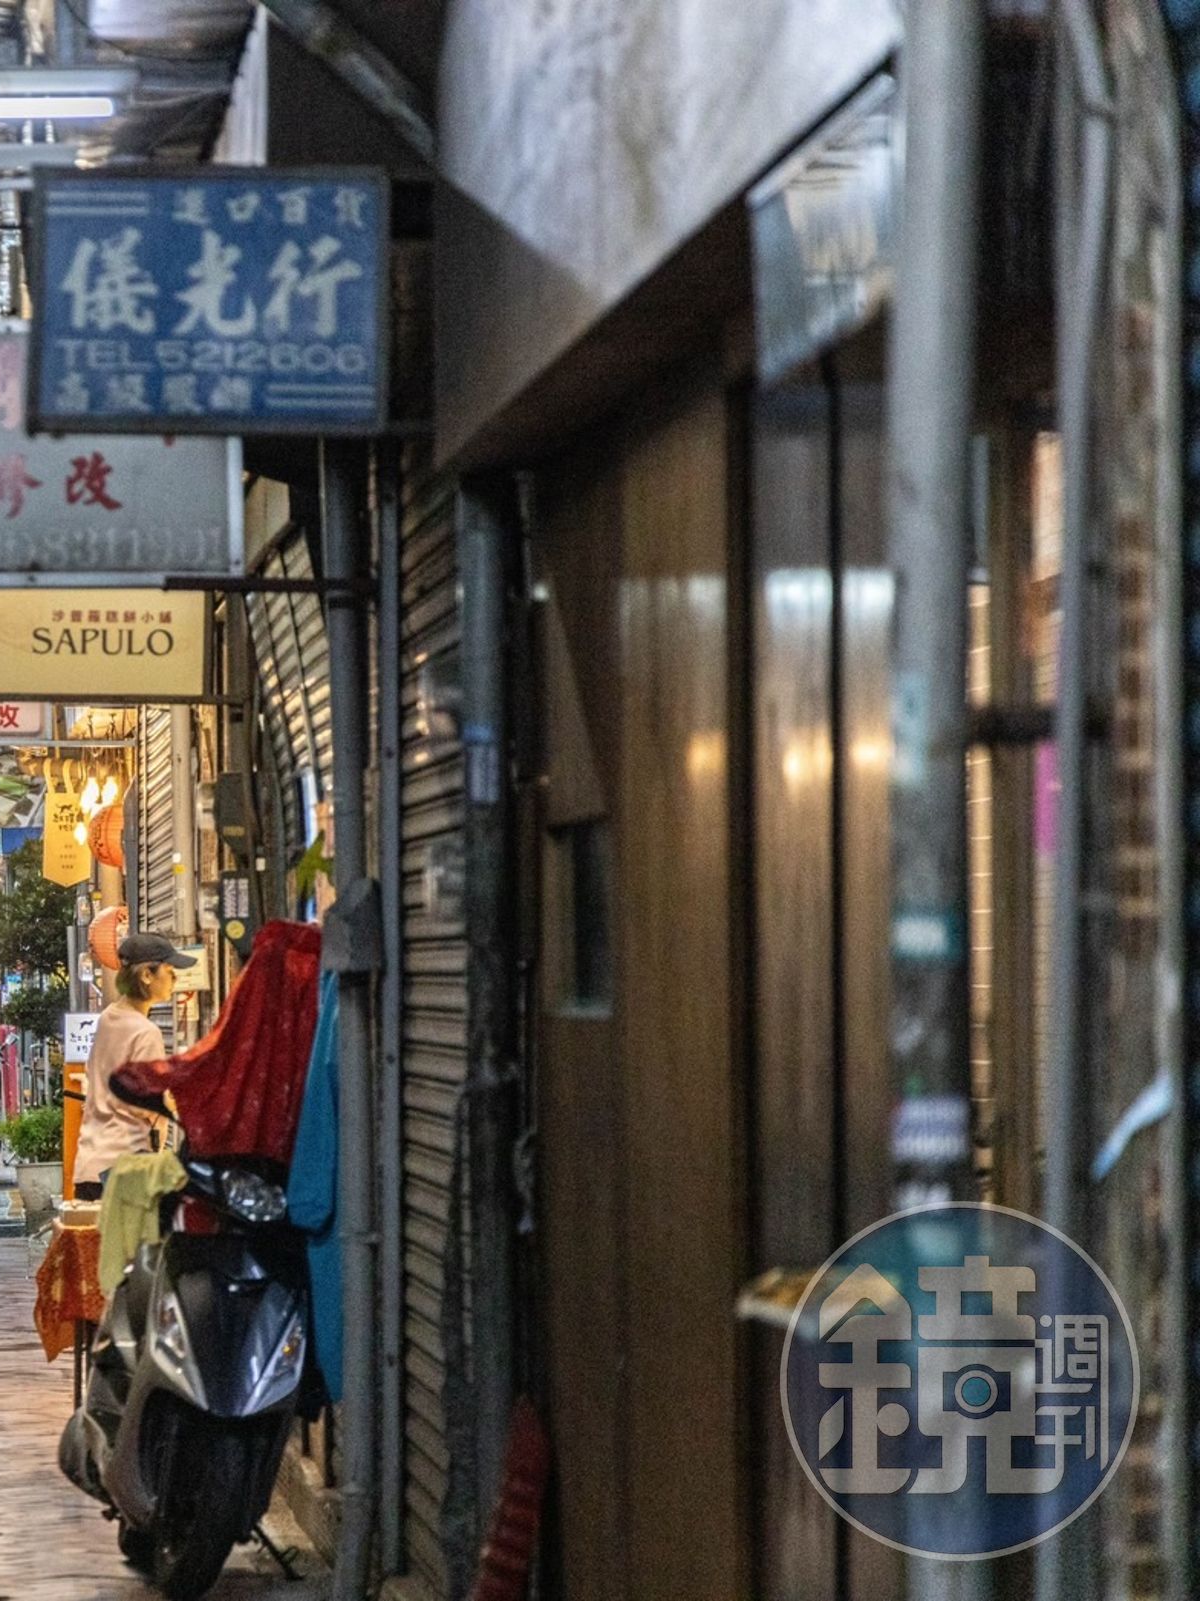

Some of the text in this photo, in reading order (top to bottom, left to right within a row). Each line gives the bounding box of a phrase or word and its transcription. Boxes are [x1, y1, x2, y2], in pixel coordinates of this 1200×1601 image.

[60, 226, 366, 338] 儀光行
[31, 626, 175, 657] SAPULO
